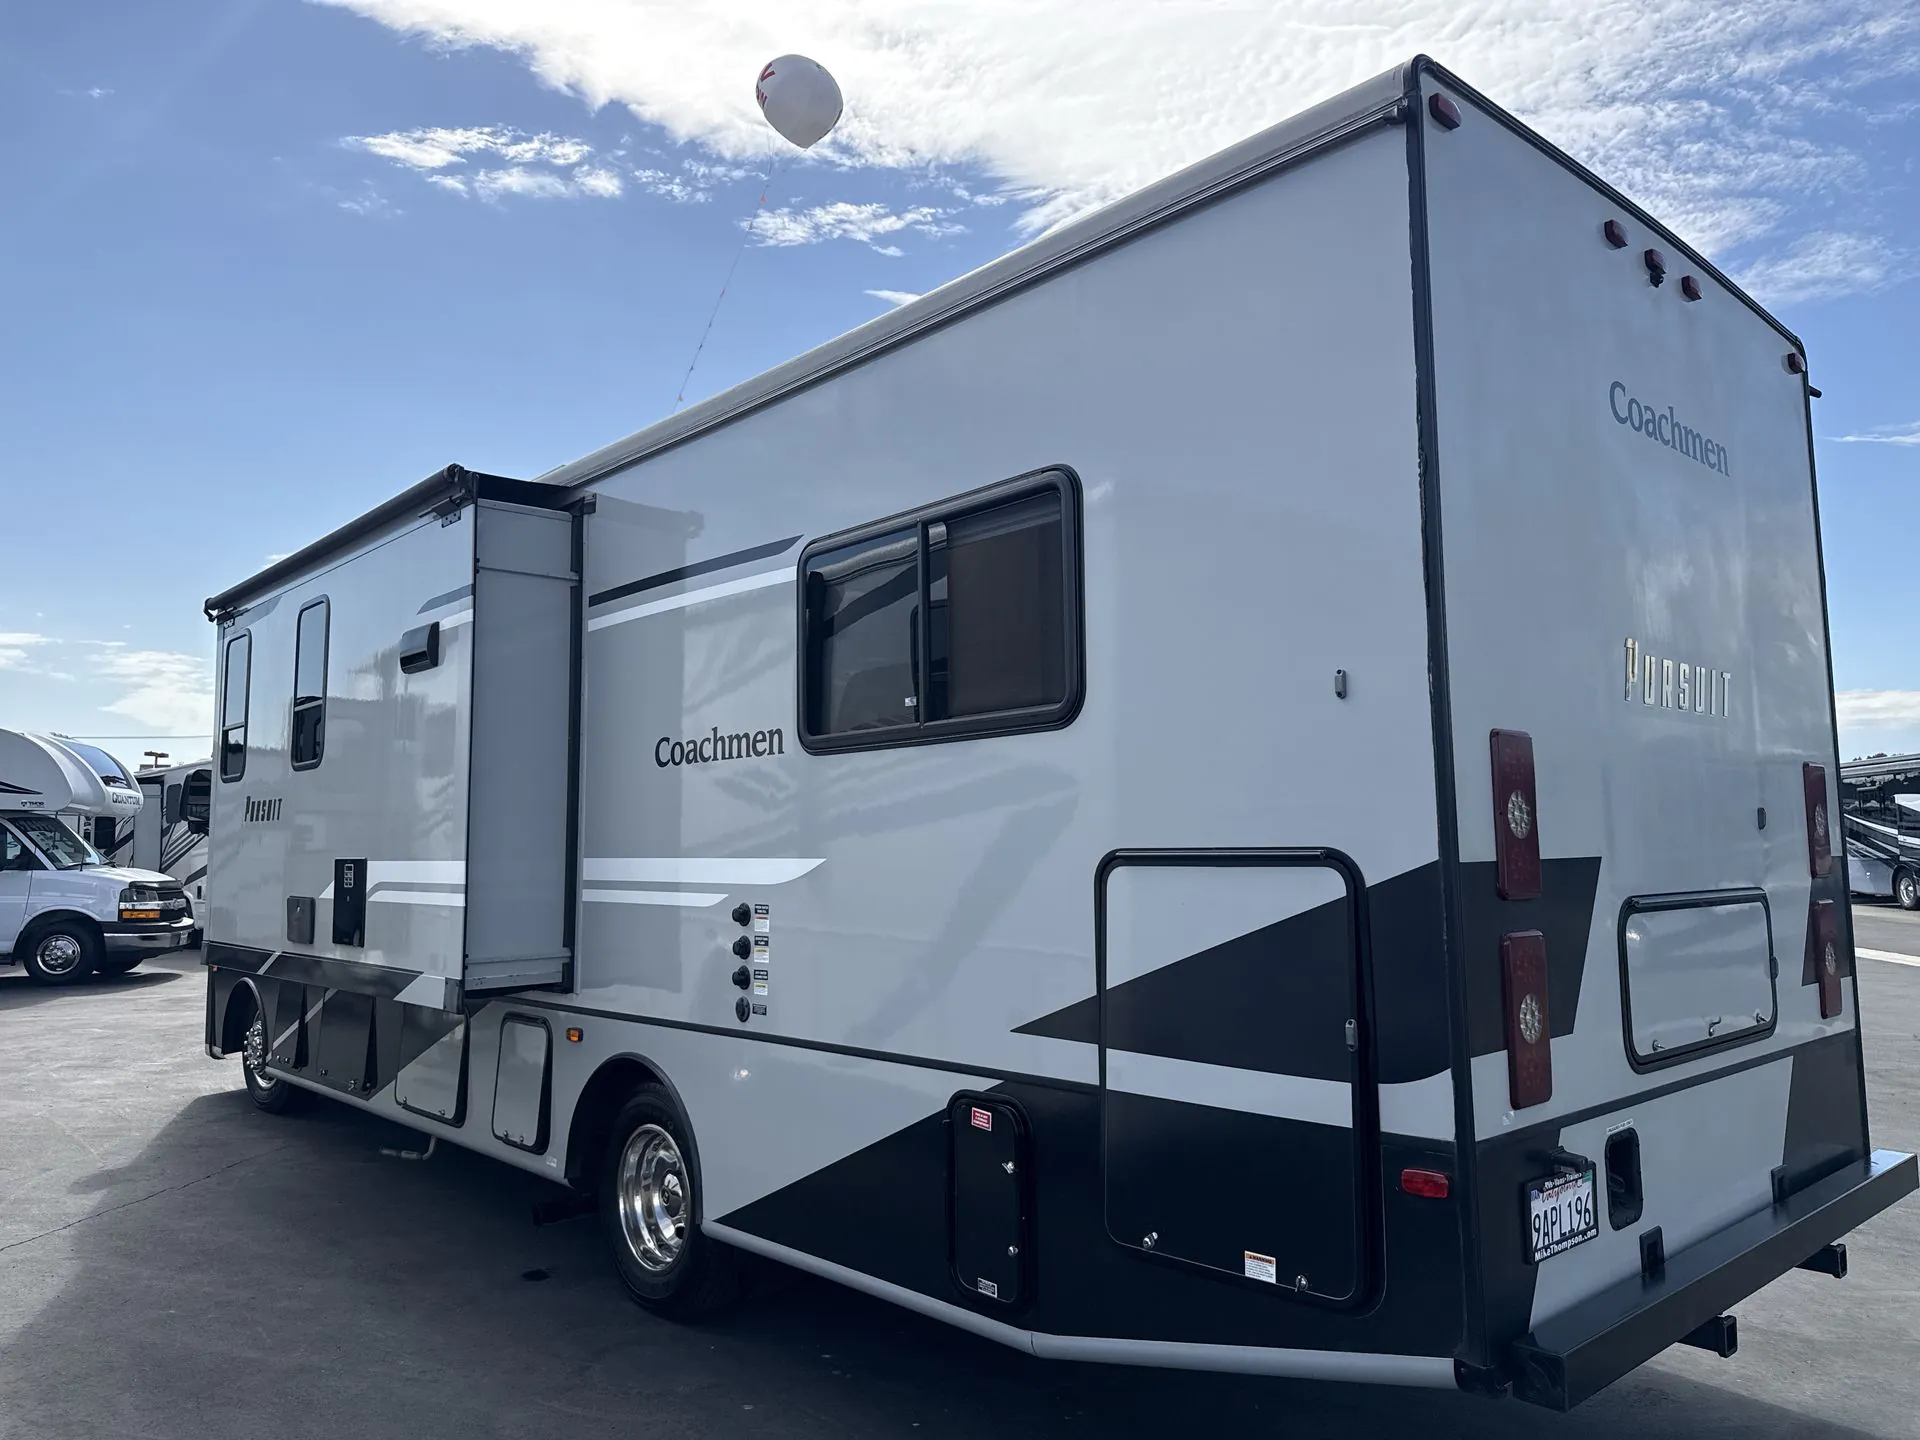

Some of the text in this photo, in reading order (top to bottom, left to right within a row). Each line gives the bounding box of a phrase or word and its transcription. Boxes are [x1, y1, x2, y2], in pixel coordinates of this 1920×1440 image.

[1609, 380, 1730, 477] Coachmen
[1624, 637, 1731, 717] PURSUIT
[655, 726, 785, 768] Coachmen
[244, 795, 283, 822] PURSUIT
[1532, 1191, 1592, 1253] 9APL196
